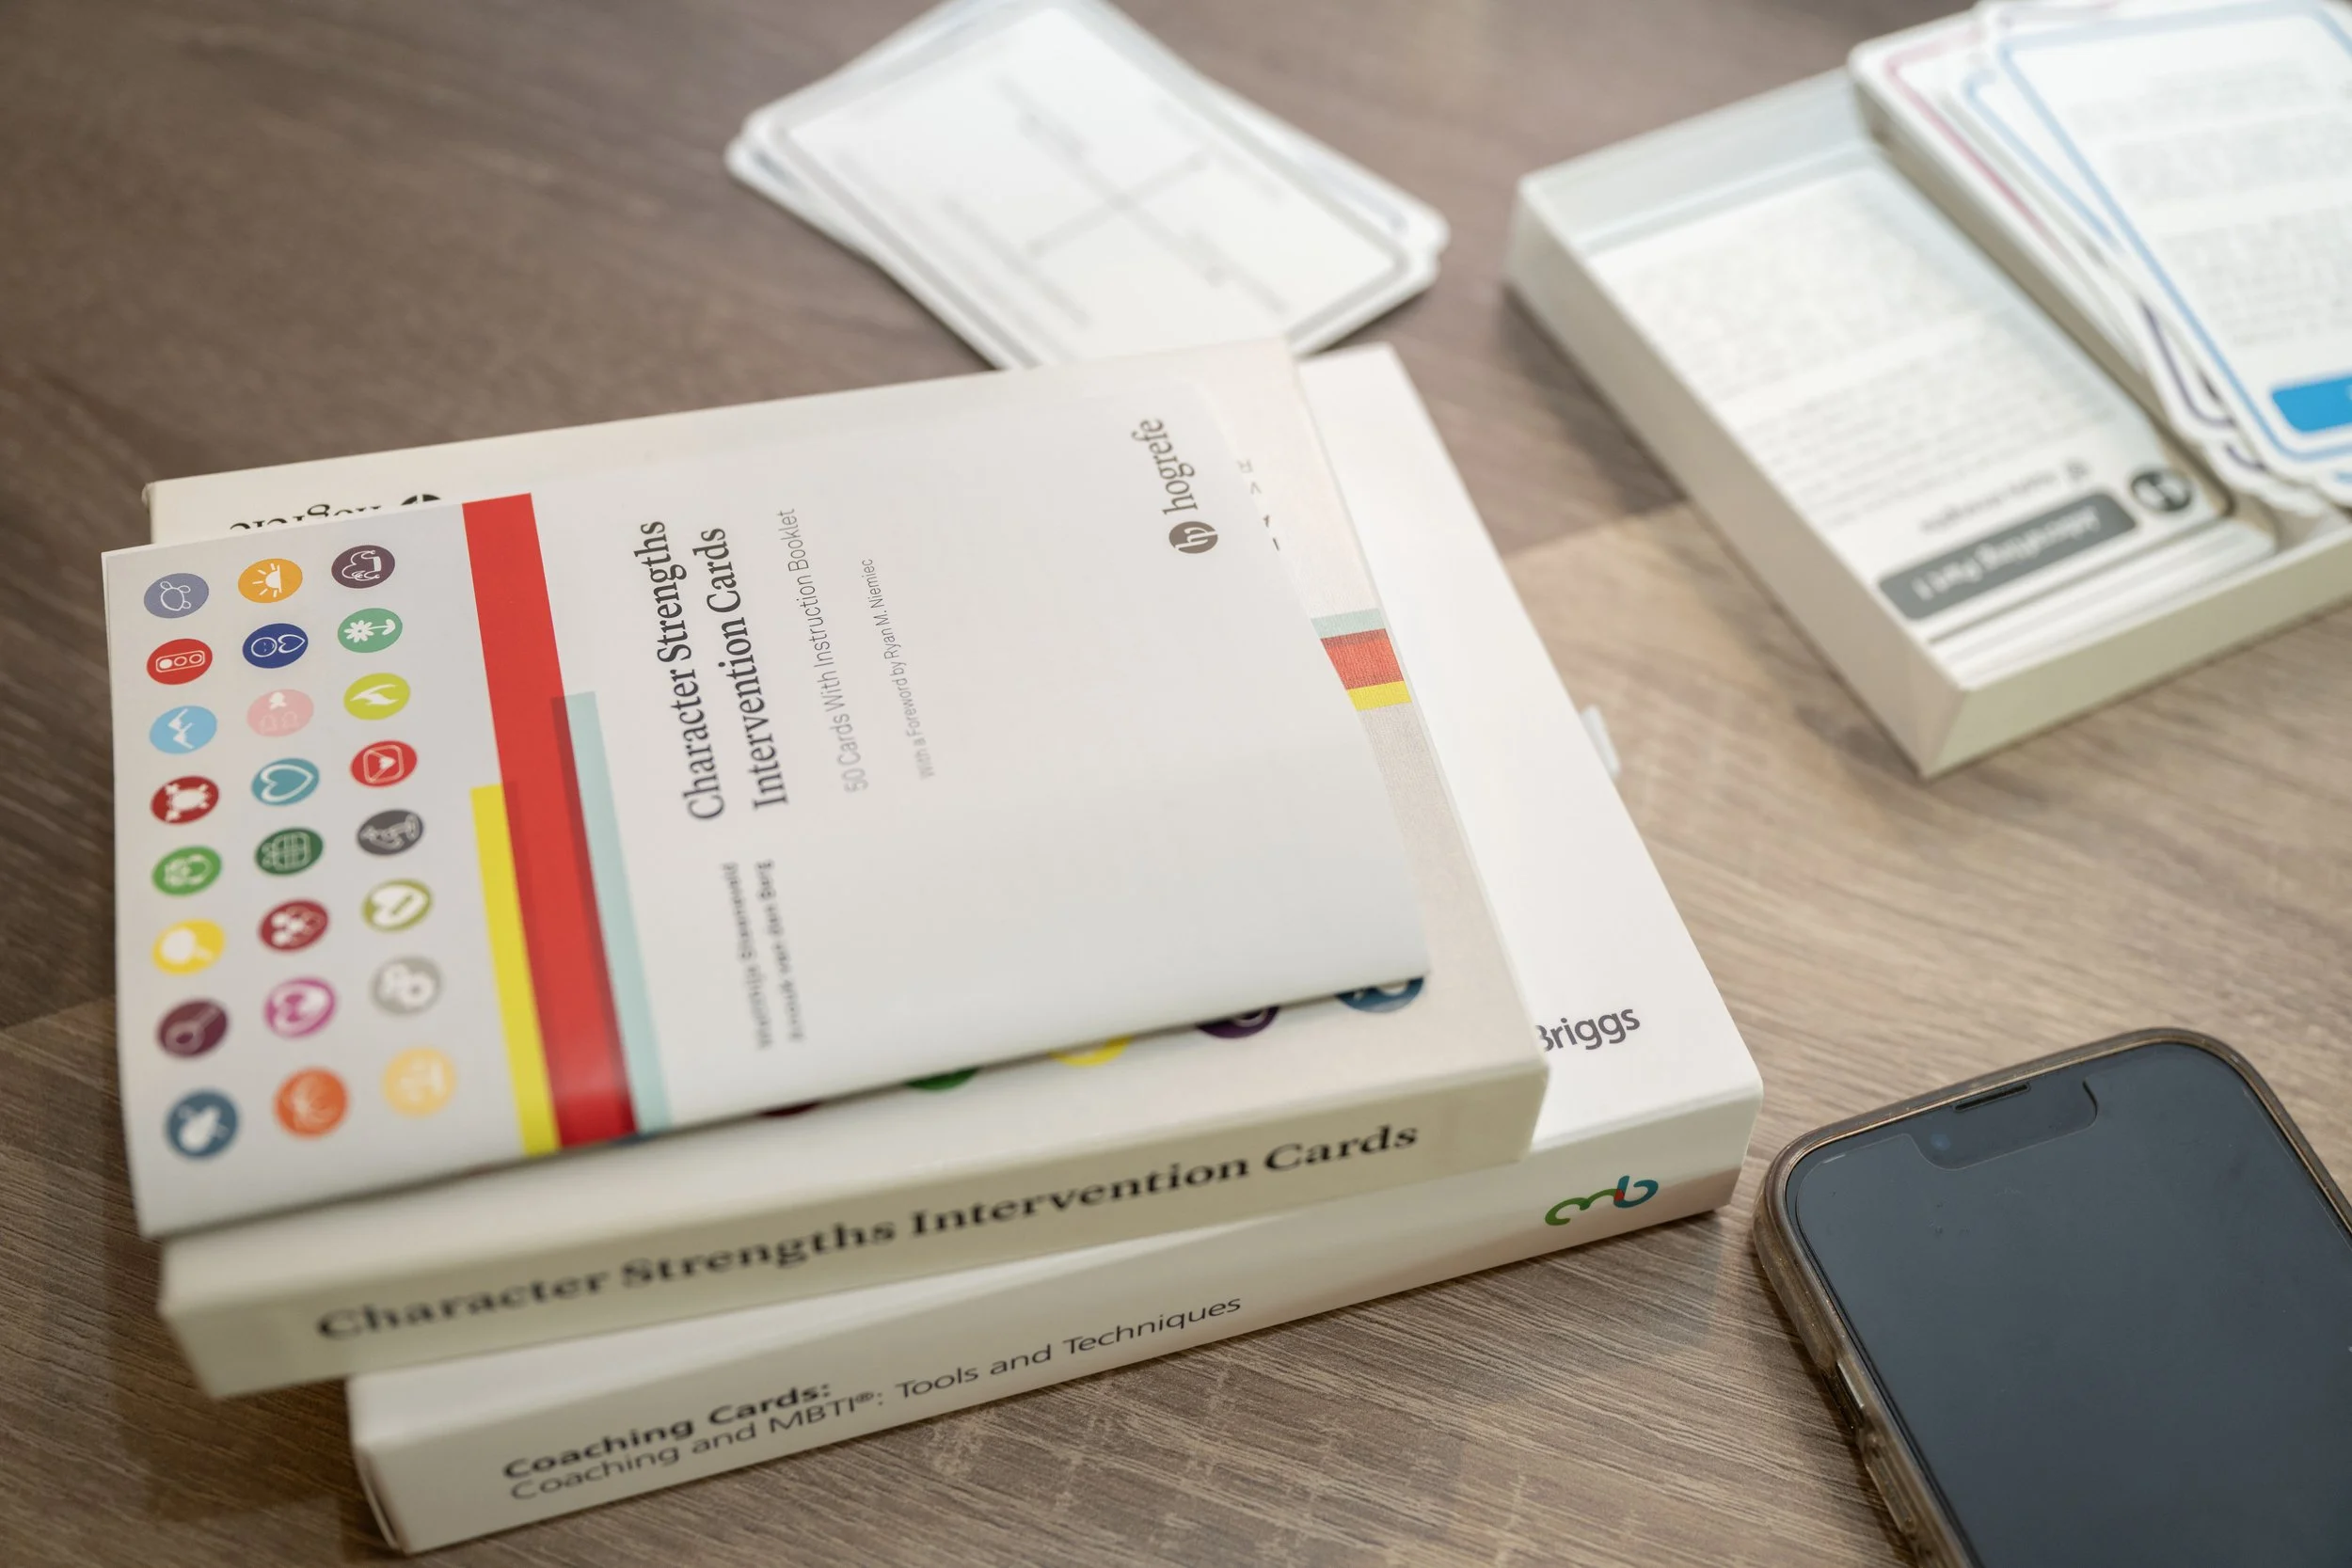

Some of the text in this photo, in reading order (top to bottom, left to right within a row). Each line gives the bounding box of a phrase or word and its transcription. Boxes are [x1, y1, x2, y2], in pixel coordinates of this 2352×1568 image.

[1131, 419, 1198, 515] hogrefe
[861, 558, 885, 610] Niemiec
[873, 610, 890, 626] M.
[633, 521, 725, 820] Character Strengths
[692, 528, 788, 811] Intervention Cards
[776, 508, 869, 794] 50 Cards With Instruction Booklet
[881, 626, 901, 660] Ryan
[888, 660, 907, 677] by
[891, 676, 921, 738] Foreword
[914, 748, 935, 781] With
[755, 860, 776, 900] Berg
[315, 1123, 1420, 1341] Character Strengths Intervention Cards
[502, 1382, 832, 1480] Coaching Cards:
[510, 1445, 680, 1501] Coaching
[691, 1421, 756, 1454] and
[895, 1365, 979, 1399] Tools
[990, 1344, 1052, 1375] and
[1063, 1297, 1242, 1354] Techniques
